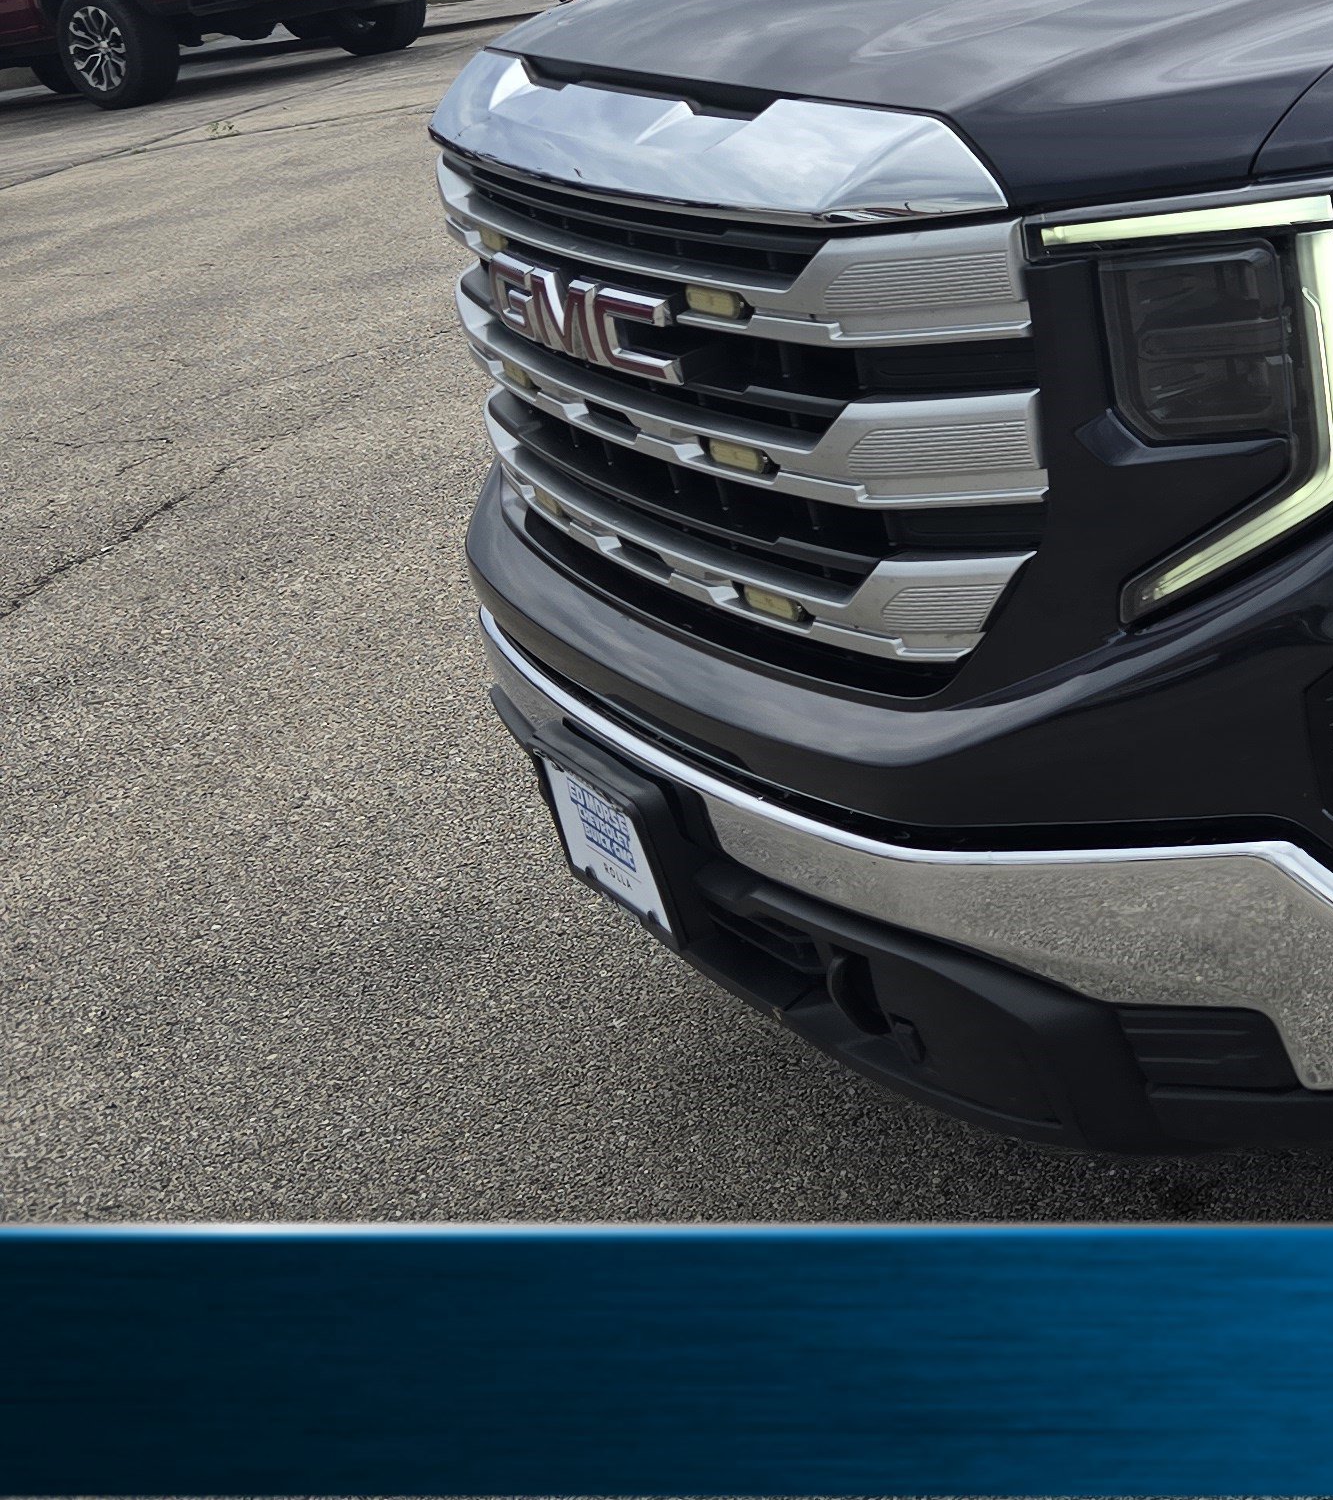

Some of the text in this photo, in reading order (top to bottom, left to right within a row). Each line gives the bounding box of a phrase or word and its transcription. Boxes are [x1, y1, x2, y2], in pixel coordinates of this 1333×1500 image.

[489, 251, 686, 386] GMC
[568, 781, 630, 835] ED MORSE
[583, 821, 613, 854] BUICK
[602, 860, 633, 891] ROLLA
